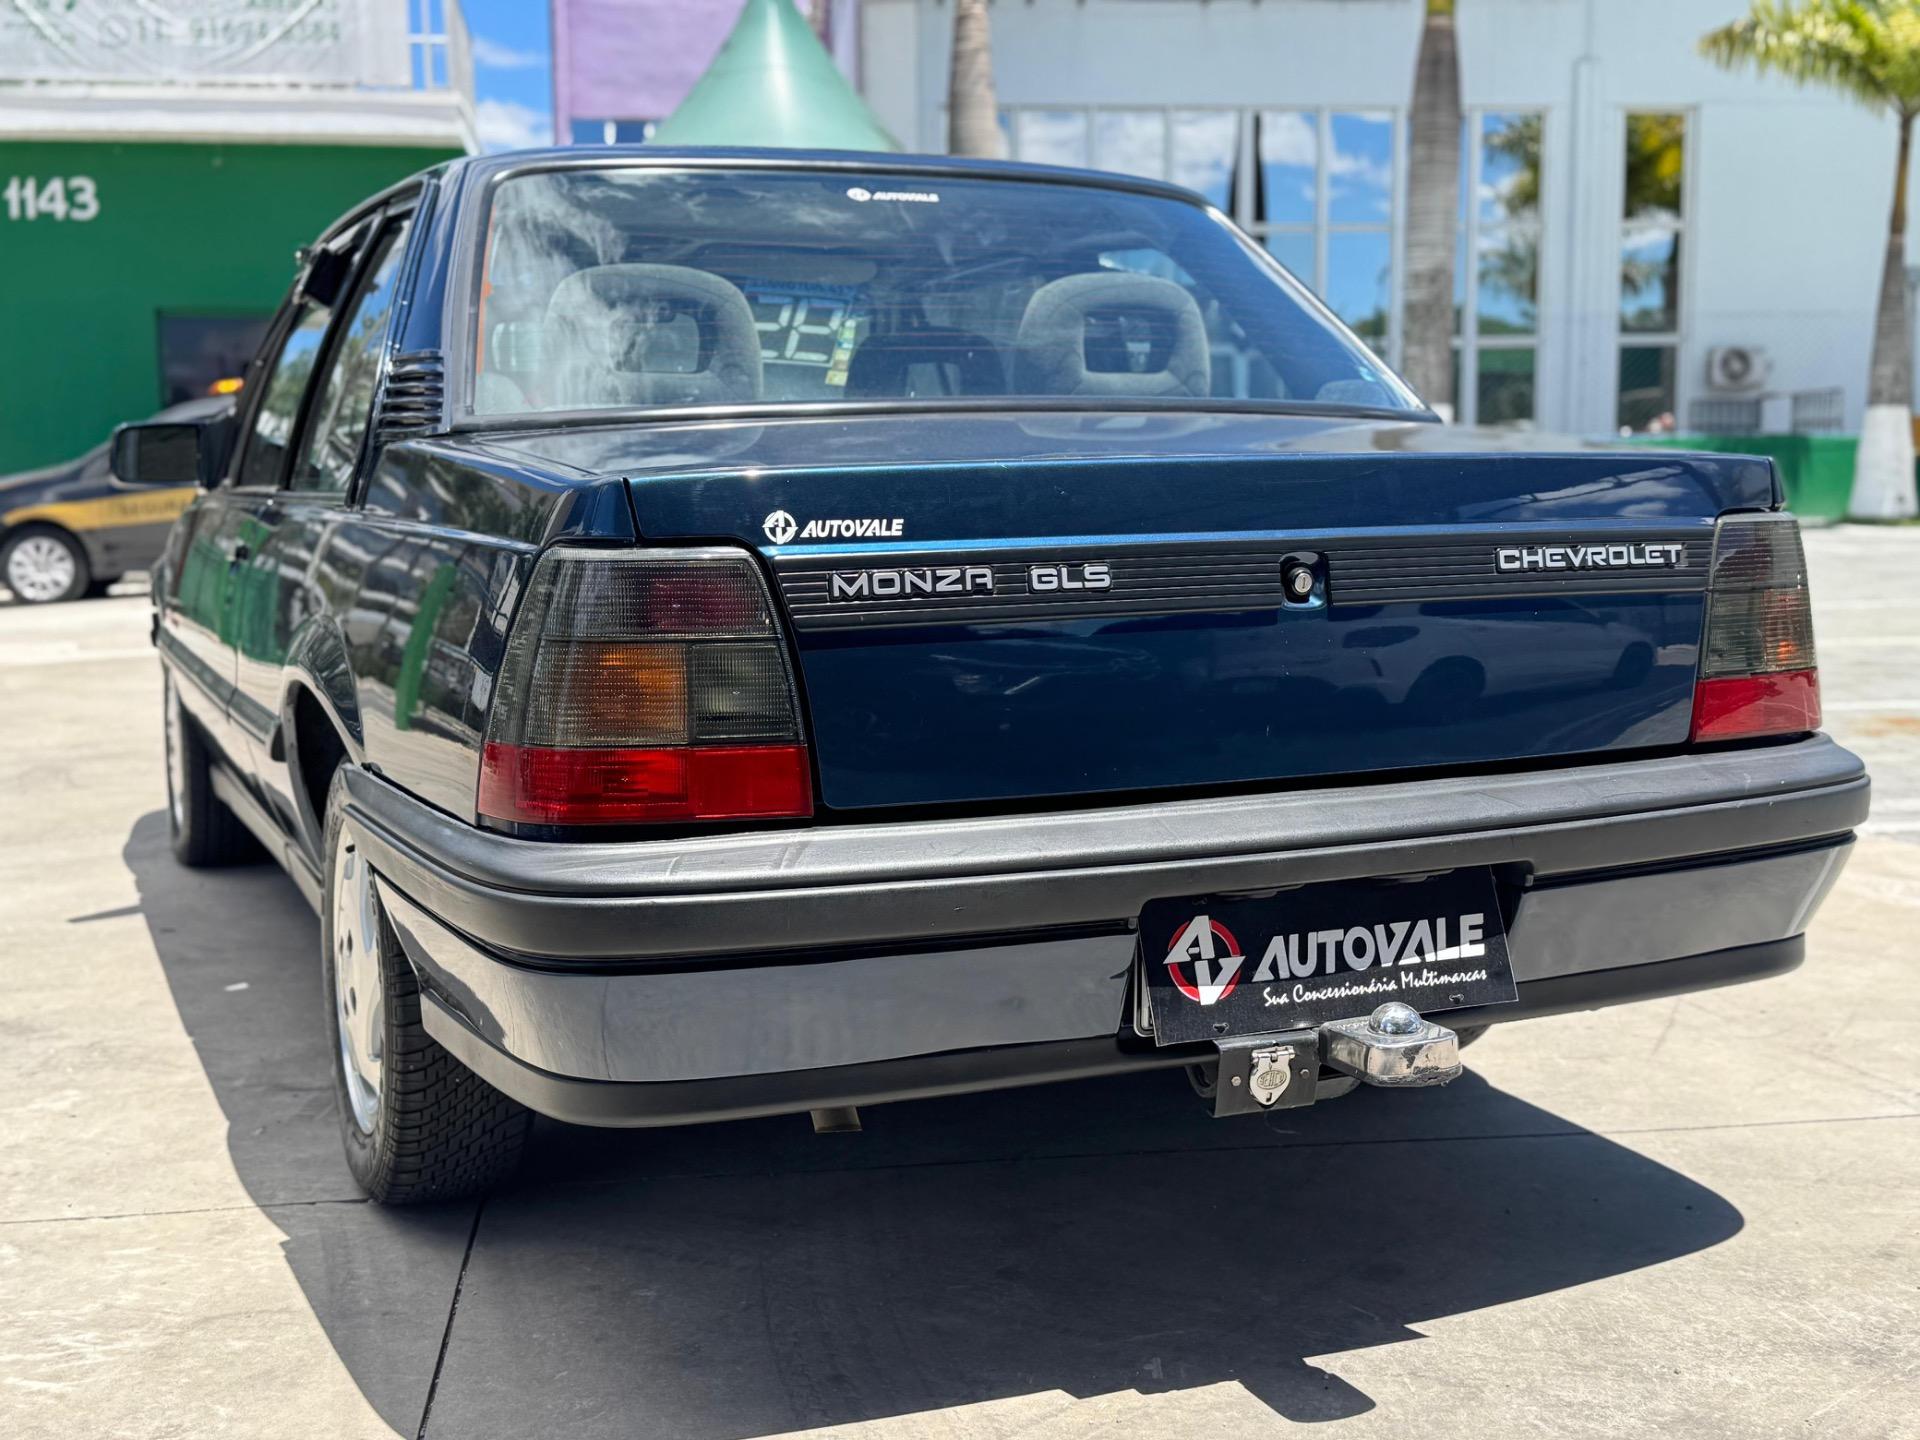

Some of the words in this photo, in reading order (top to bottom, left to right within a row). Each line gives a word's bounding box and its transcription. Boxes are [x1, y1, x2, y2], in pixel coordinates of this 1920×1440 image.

[3, 175, 99, 221] 1143
[800, 519, 904, 538] AUTOVALE
[1500, 544, 1682, 569] CHEVROLET
[832, 567, 994, 597] MONZA
[1031, 564, 1112, 591] GLS
[1251, 912, 1486, 983] AUTOVALE
[1263, 986, 1289, 1007] Sua
[1293, 972, 1398, 1004] Concessionária
[1401, 968, 1488, 989] Multimarcas
